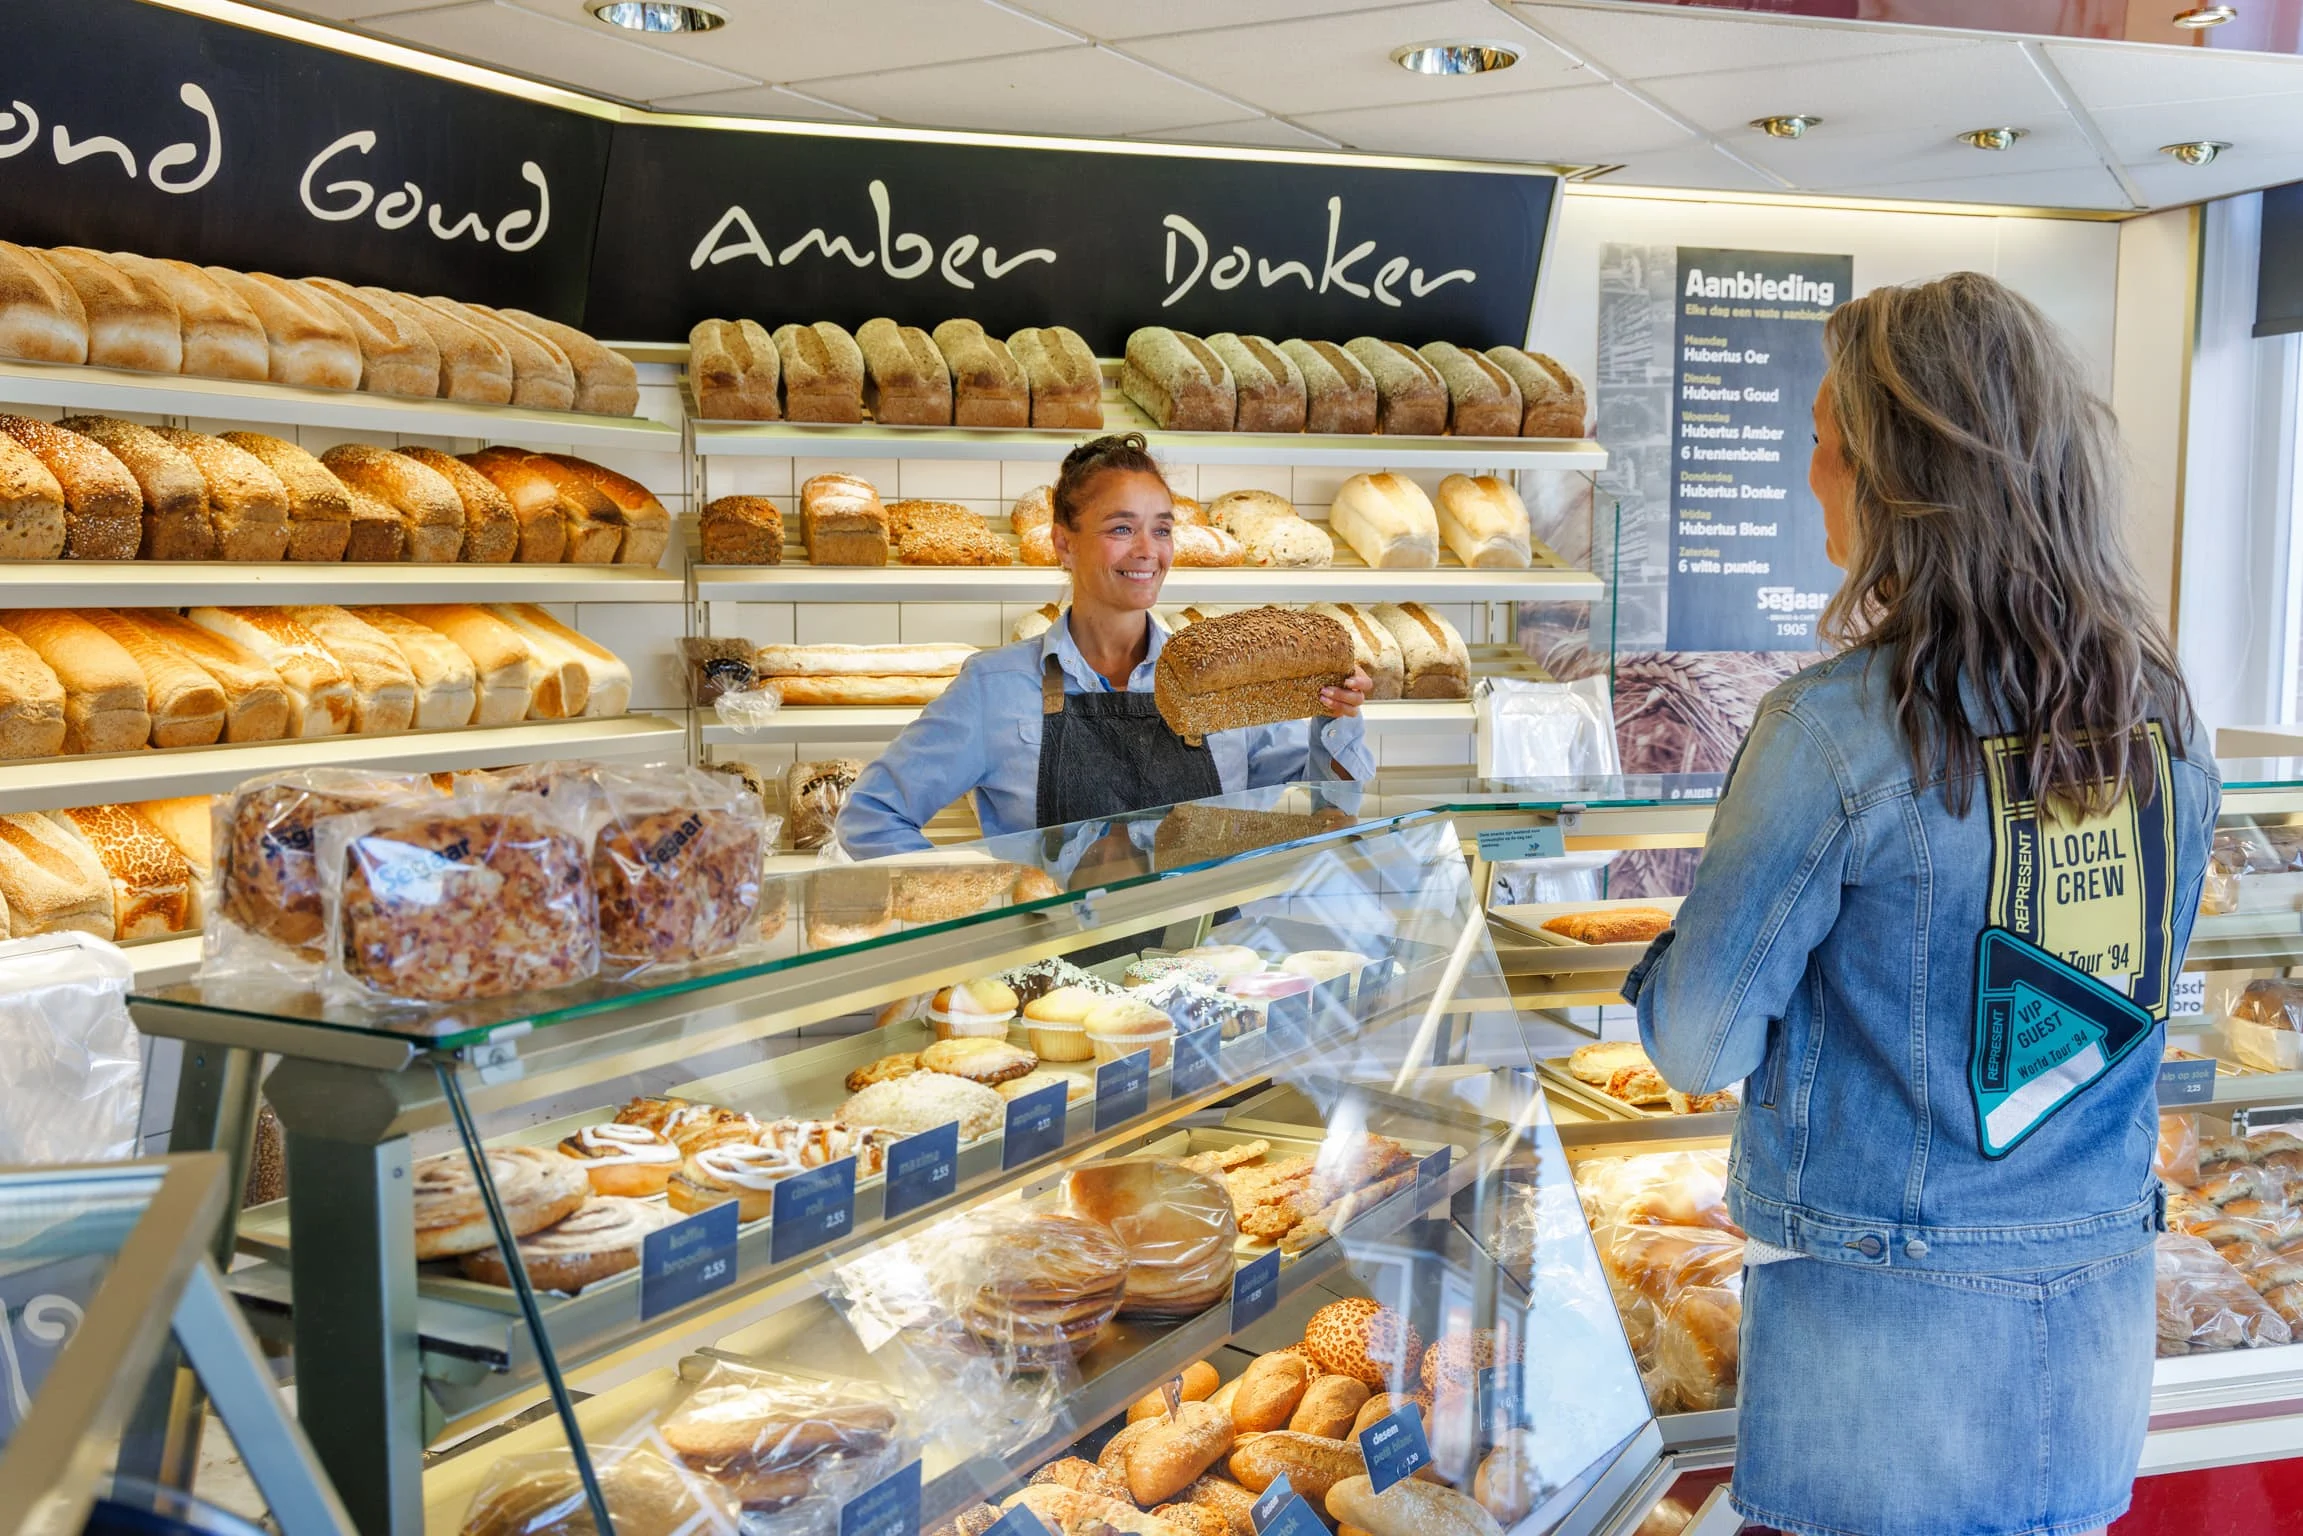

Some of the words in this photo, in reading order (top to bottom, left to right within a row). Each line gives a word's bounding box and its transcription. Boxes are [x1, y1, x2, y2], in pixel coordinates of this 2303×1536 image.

[300, 130, 551, 253] Goud
[690, 179, 1057, 289] Amber
[1162, 196, 1476, 307] Donker
[1685, 268, 1835, 306] Aanbieding
[1684, 347, 1741, 364] Hubertus
[1744, 349, 1770, 365] Oer
[1682, 385, 1740, 402] Hubertus
[1743, 387, 1779, 403] Goud
[1681, 423, 1739, 440] Hubertus
[1742, 425, 1784, 441] Amber
[1680, 446, 1690, 460] 6
[1693, 446, 1780, 462] krentenbollen
[1680, 484, 1737, 499] Hubertus
[1741, 485, 1787, 500] Donker
[1679, 521, 1737, 536] Hubertus
[1740, 522, 1777, 537] Blond
[1678, 559, 1688, 573] 6
[1690, 560, 1721, 573] witte
[1757, 587, 1829, 612] Segaar
[1776, 623, 1808, 636] 1905
[2050, 828, 2127, 869] LOCAL
[2014, 829, 2033, 934] REPRESENT
[2056, 864, 2124, 905] CREW
[2068, 949, 2104, 974] Tour
[2107, 942, 2129, 970] '94
[2017, 999, 2043, 1024] VIP
[2017, 1009, 2063, 1049] GUEST
[1987, 1008, 2005, 1081] REPRESENT
[2017, 1055, 2050, 1080] World
[2048, 1043, 2072, 1063] Tour
[2071, 1029, 2089, 1047] '94
[1373, 1424, 1399, 1446] desem
